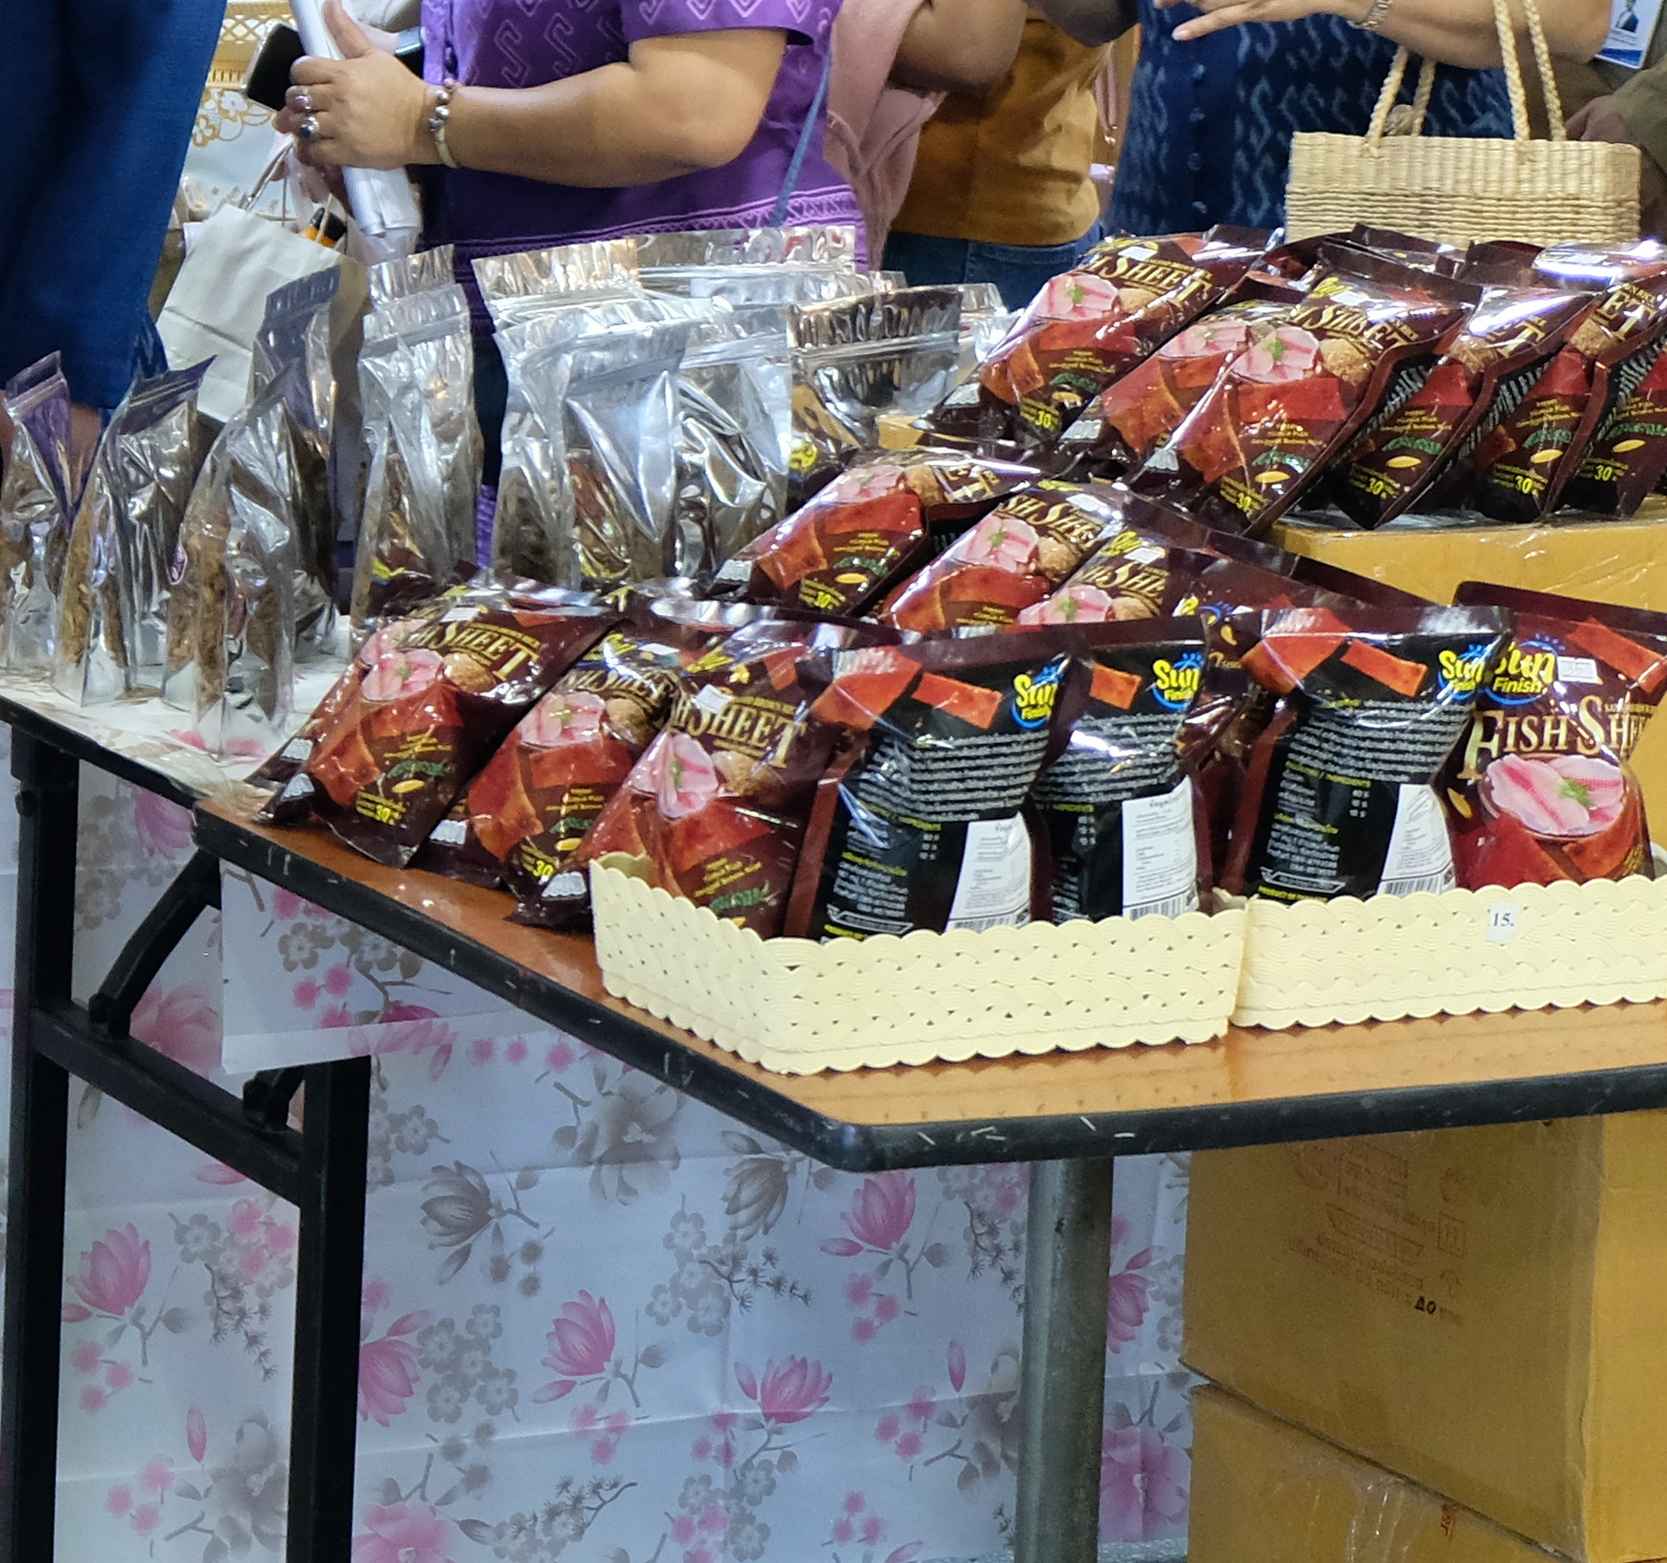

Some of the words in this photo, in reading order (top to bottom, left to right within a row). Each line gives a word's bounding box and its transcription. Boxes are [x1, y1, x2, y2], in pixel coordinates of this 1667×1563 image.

[1013, 673, 1058, 708] Sun
[1152, 659, 1200, 691] Sun
[1493, 676, 1544, 694] Finish
[1456, 709, 1569, 780] FISH
